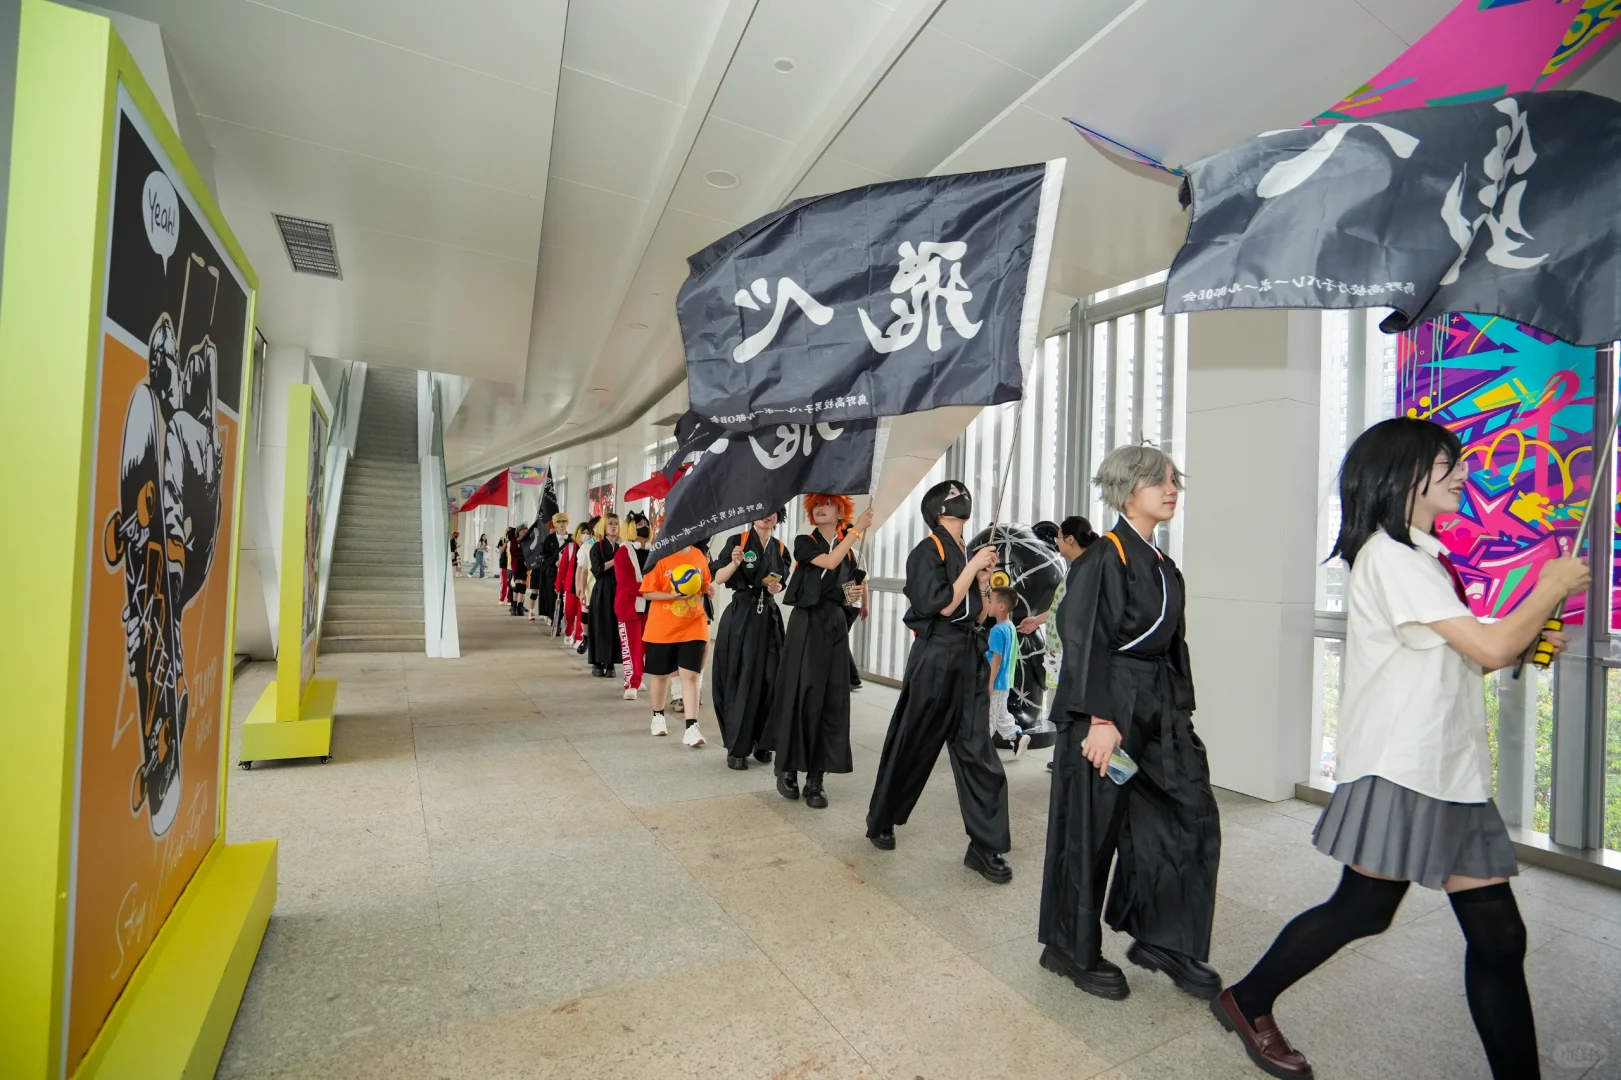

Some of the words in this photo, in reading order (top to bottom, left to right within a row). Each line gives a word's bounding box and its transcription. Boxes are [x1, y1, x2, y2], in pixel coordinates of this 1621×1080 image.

[148, 188, 176, 237] Yeah!
[126, 542, 175, 713] SKATER
[617, 621, 631, 660] VOLLEYBA
